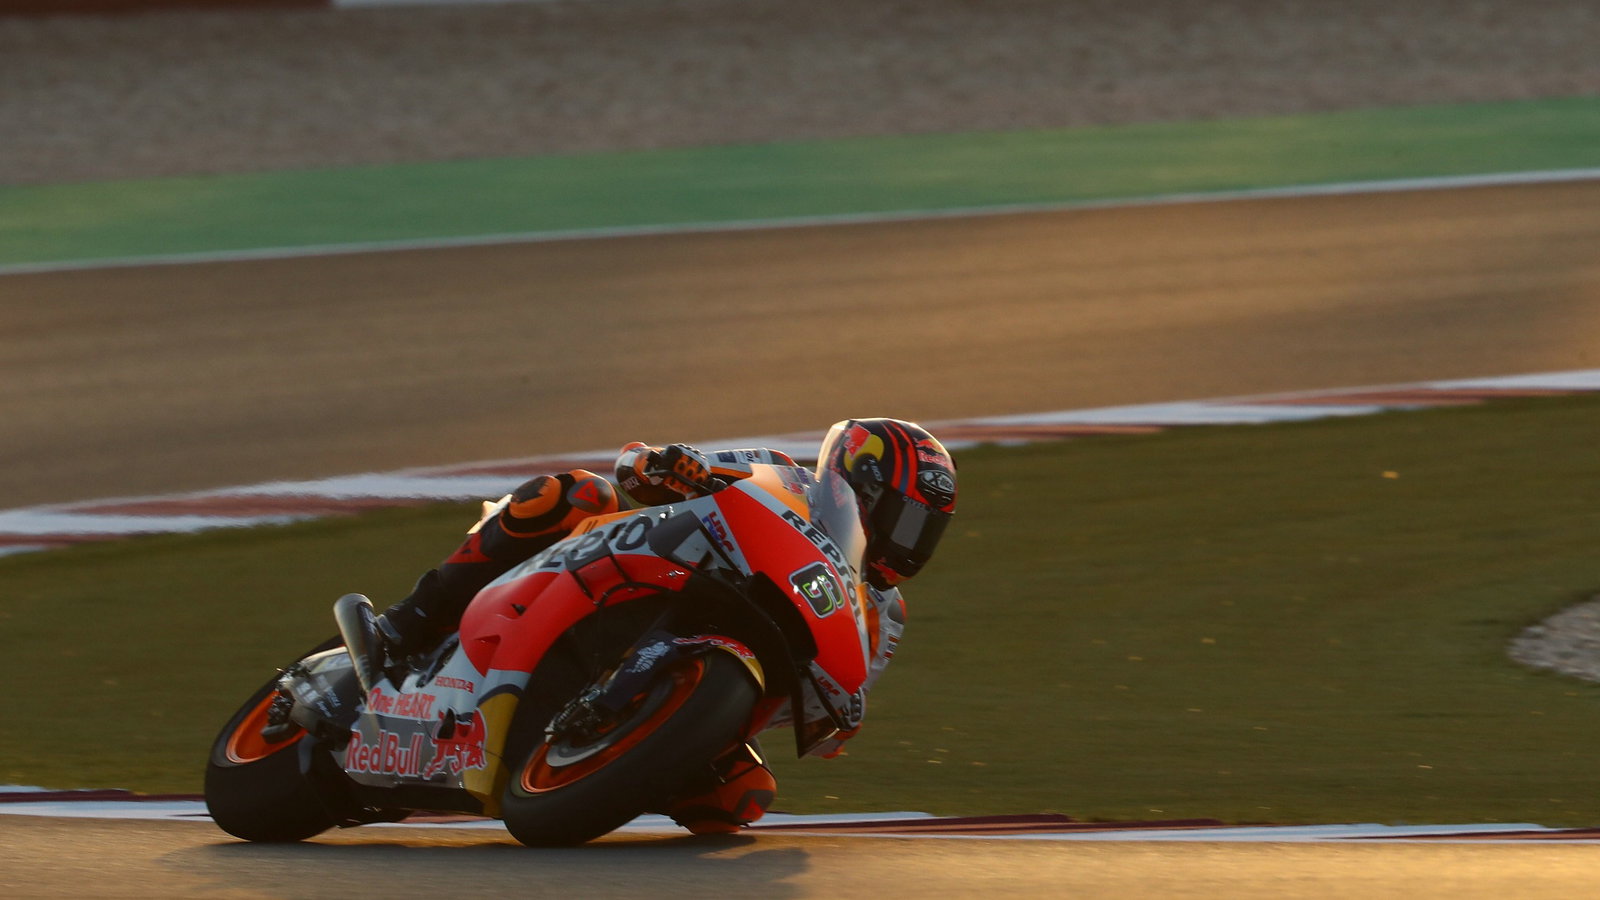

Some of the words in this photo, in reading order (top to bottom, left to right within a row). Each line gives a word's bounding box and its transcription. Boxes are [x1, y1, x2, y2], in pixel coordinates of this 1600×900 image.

[782, 510, 861, 627] REPSOL
[435, 676, 473, 693] HONDA
[345, 730, 386, 772] Red
[385, 732, 425, 777] Bull
